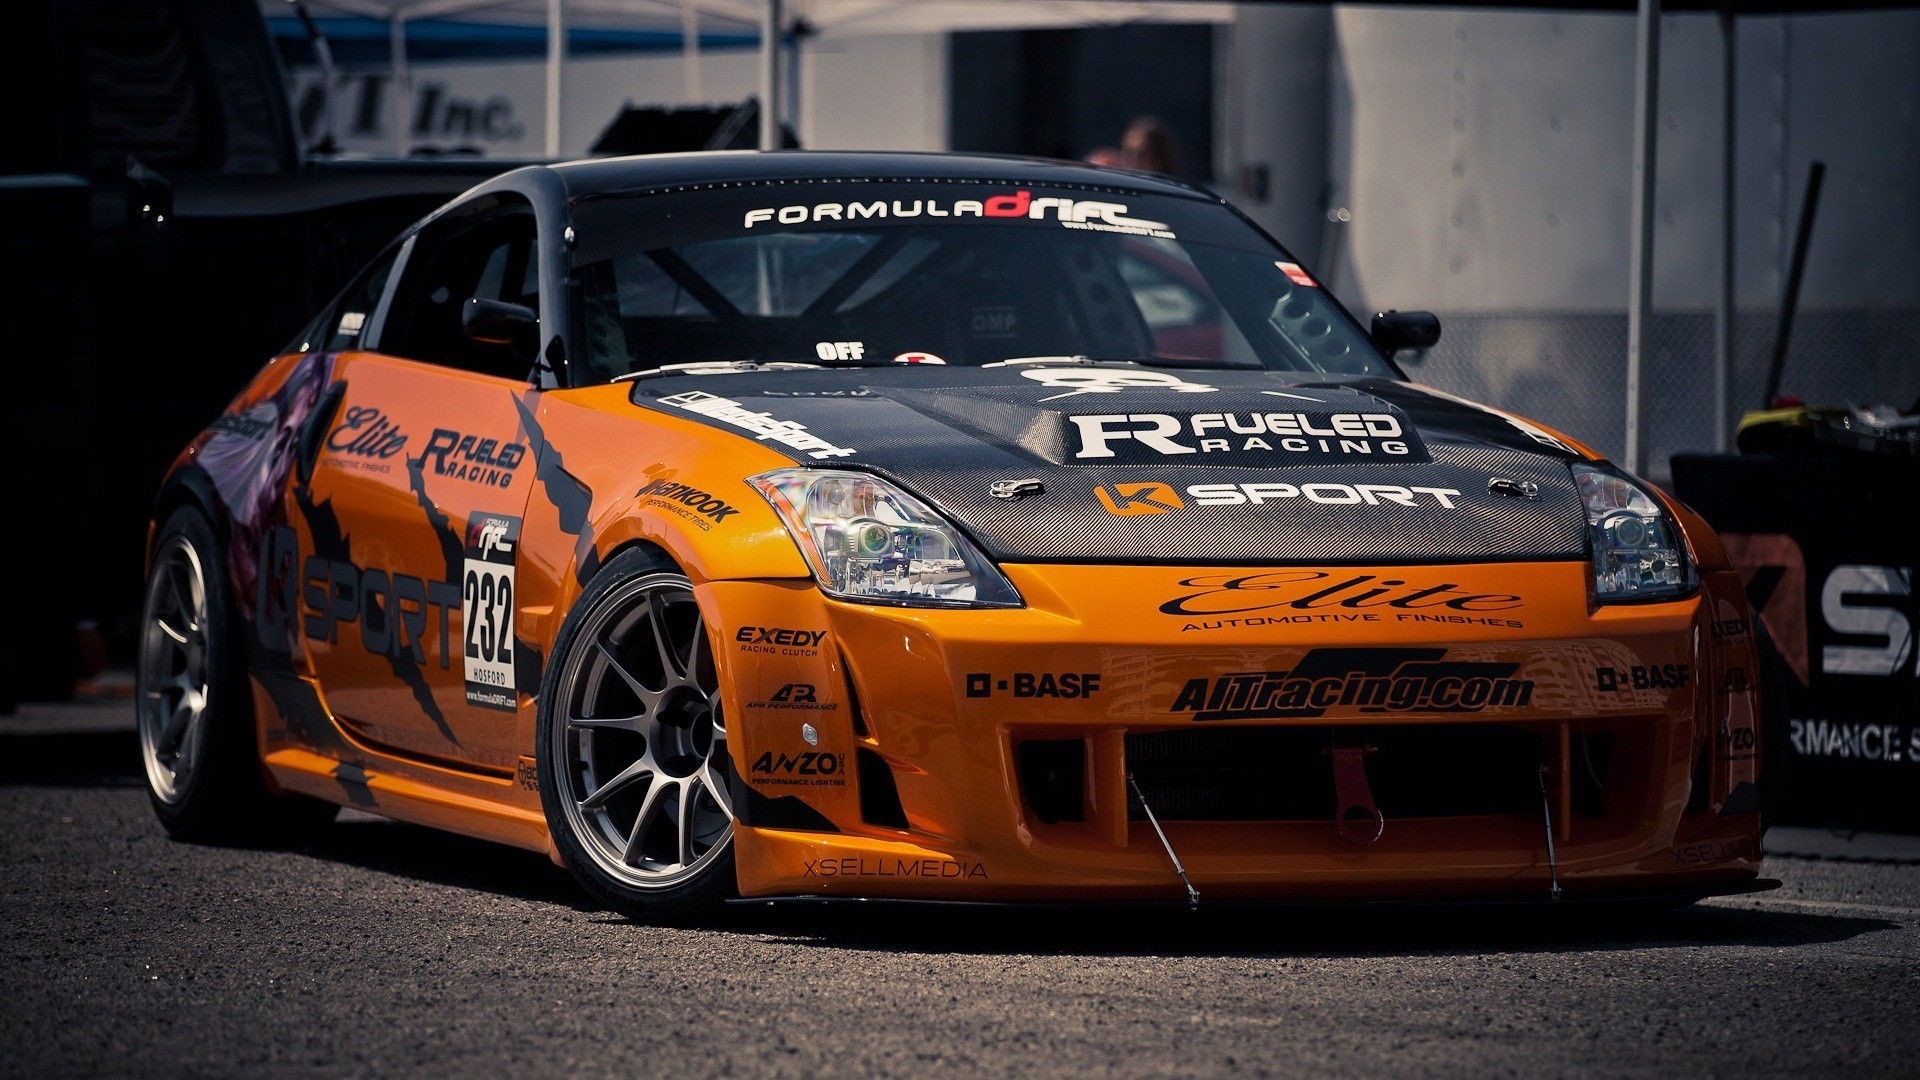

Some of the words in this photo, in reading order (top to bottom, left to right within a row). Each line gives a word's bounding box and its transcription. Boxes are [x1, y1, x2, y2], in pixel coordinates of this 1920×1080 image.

[410, 80, 525, 141] Inc.
[816, 341, 864, 360] OFF
[328, 406, 409, 460] Elite
[1193, 413, 1403, 438] FUELED
[453, 435, 526, 471] FUELED
[1200, 439, 1410, 455] RACING
[445, 461, 514, 489] RACING
[1186, 483, 1462, 510] SPORT
[1158, 571, 1525, 617] Elite
[303, 556, 462, 671] SPORT
[465, 569, 513, 666] 232
[1181, 613, 1380, 633] AUTOMOTIVE
[1396, 613, 1525, 630] FINISHES
[735, 626, 828, 648] EXEDY
[741, 645, 776, 655] RACING
[782, 648, 818, 657] CLUTCH
[473, 667, 506, 686] HOSFORD
[1014, 673, 1101, 699] BASF
[1630, 664, 1689, 690] BASF
[768, 703, 838, 711] PERFORMANCE
[752, 751, 837, 776] ANZO
[838, 753, 846, 776] USA
[752, 778, 809, 786] PERFORMANCE
[811, 779, 846, 787] LIGHTING
[803, 858, 988, 881] XSELLMEDIA
